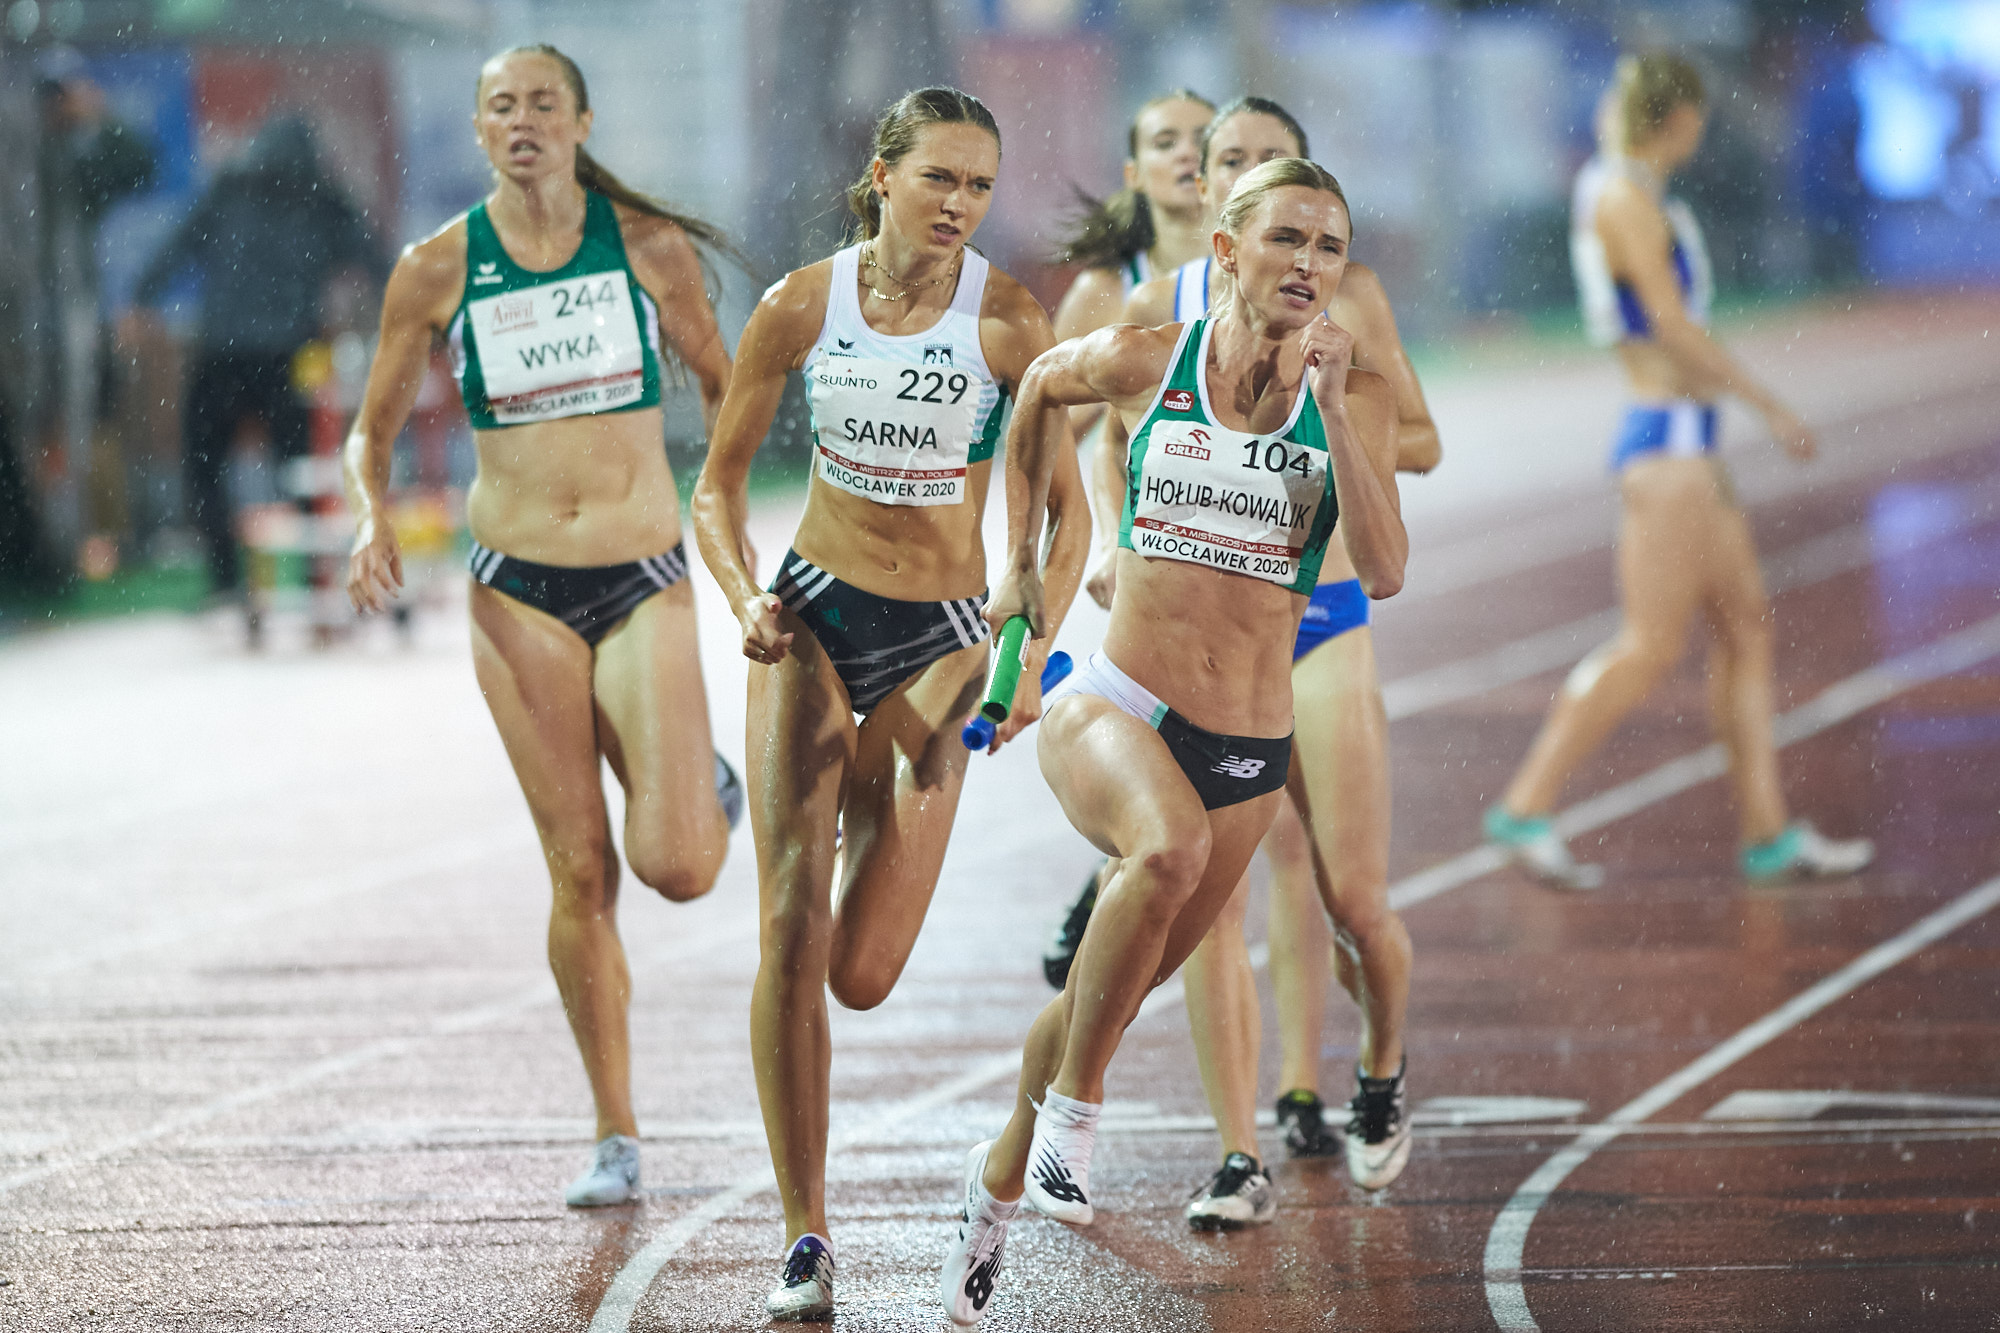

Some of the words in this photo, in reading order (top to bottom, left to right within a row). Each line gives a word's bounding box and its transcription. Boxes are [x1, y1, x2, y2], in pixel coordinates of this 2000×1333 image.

[552, 280, 618, 318] 244
[518, 334, 603, 370] WYKA
[820, 374, 878, 390] SUUNTO
[896, 368, 969, 405] 229
[843, 417, 938, 450] SARNA
[1166, 444, 1209, 460] ORLEN
[1241, 439, 1312, 479] 104
[826, 461, 917, 497] WŁOCŁAWEK
[922, 481, 956, 497] 2020
[859, 465, 925, 478] MISTRZOSTWA
[926, 470, 957, 478] POLSKI
[1145, 476, 1312, 530] HOŁUB-KOWALIK
[1141, 532, 1250, 570] WŁOCŁAWEK
[1253, 557, 1289, 576] 2020
[1161, 523, 1187, 536] PZLA
[1188, 530, 1258, 552] MISTRZOSTWA
